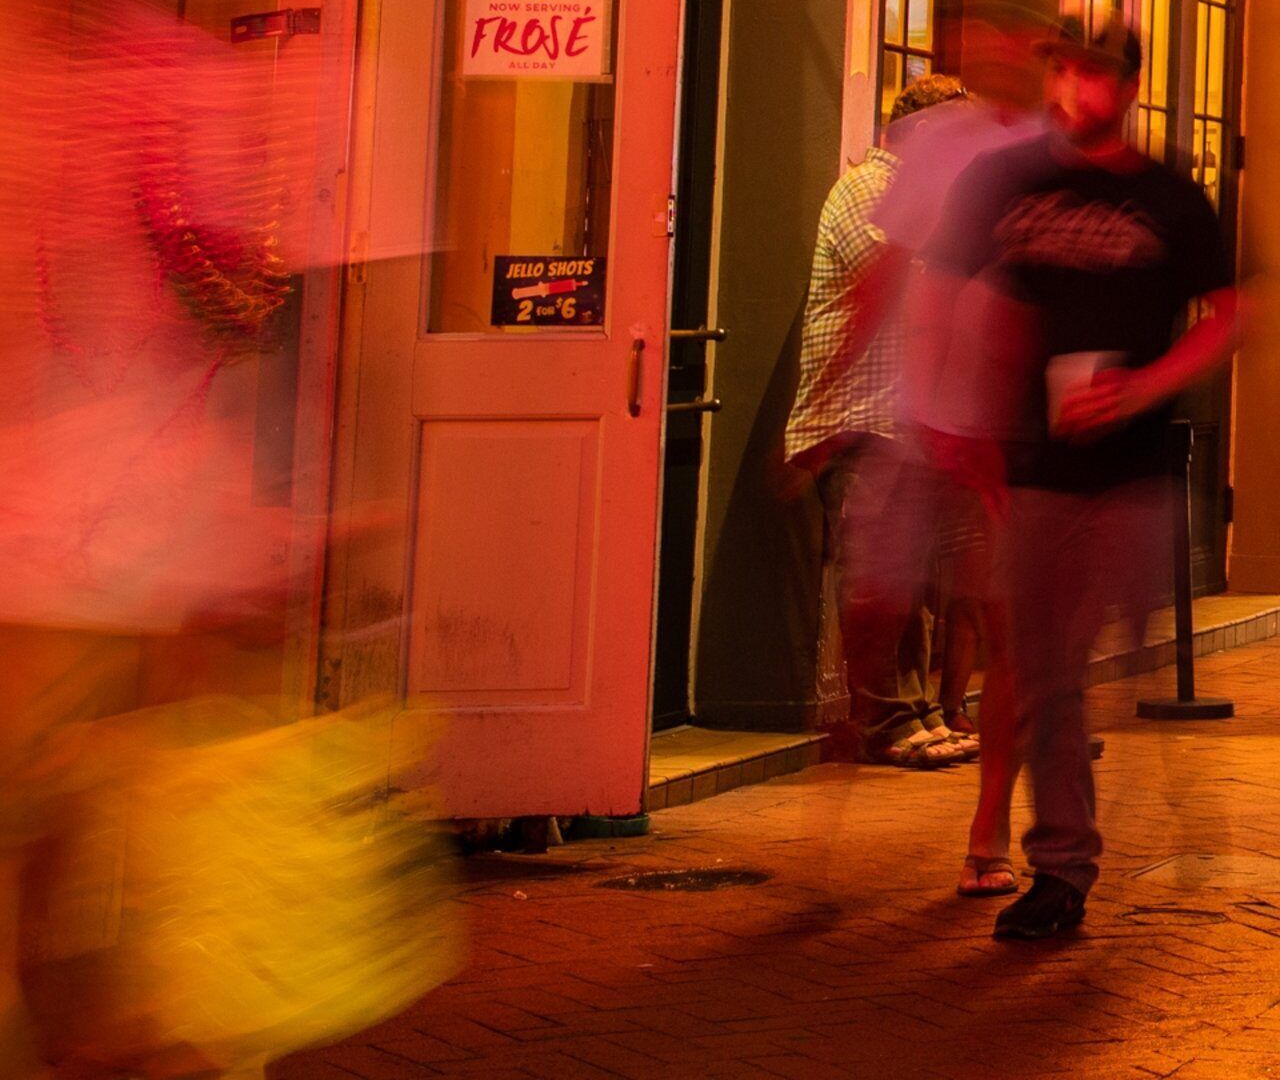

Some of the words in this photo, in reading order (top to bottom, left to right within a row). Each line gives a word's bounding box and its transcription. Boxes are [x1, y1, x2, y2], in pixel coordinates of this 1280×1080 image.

[489, 3, 520, 11] NOW
[526, 3, 580, 12] SERVING
[471, 6, 597, 60] FROSÉ
[506, 263, 544, 278] JELLO
[548, 260, 594, 276] SHOTS
[517, 300, 533, 322] 2
[536, 306, 555, 316] FOR
[556, 297, 576, 319] $6
